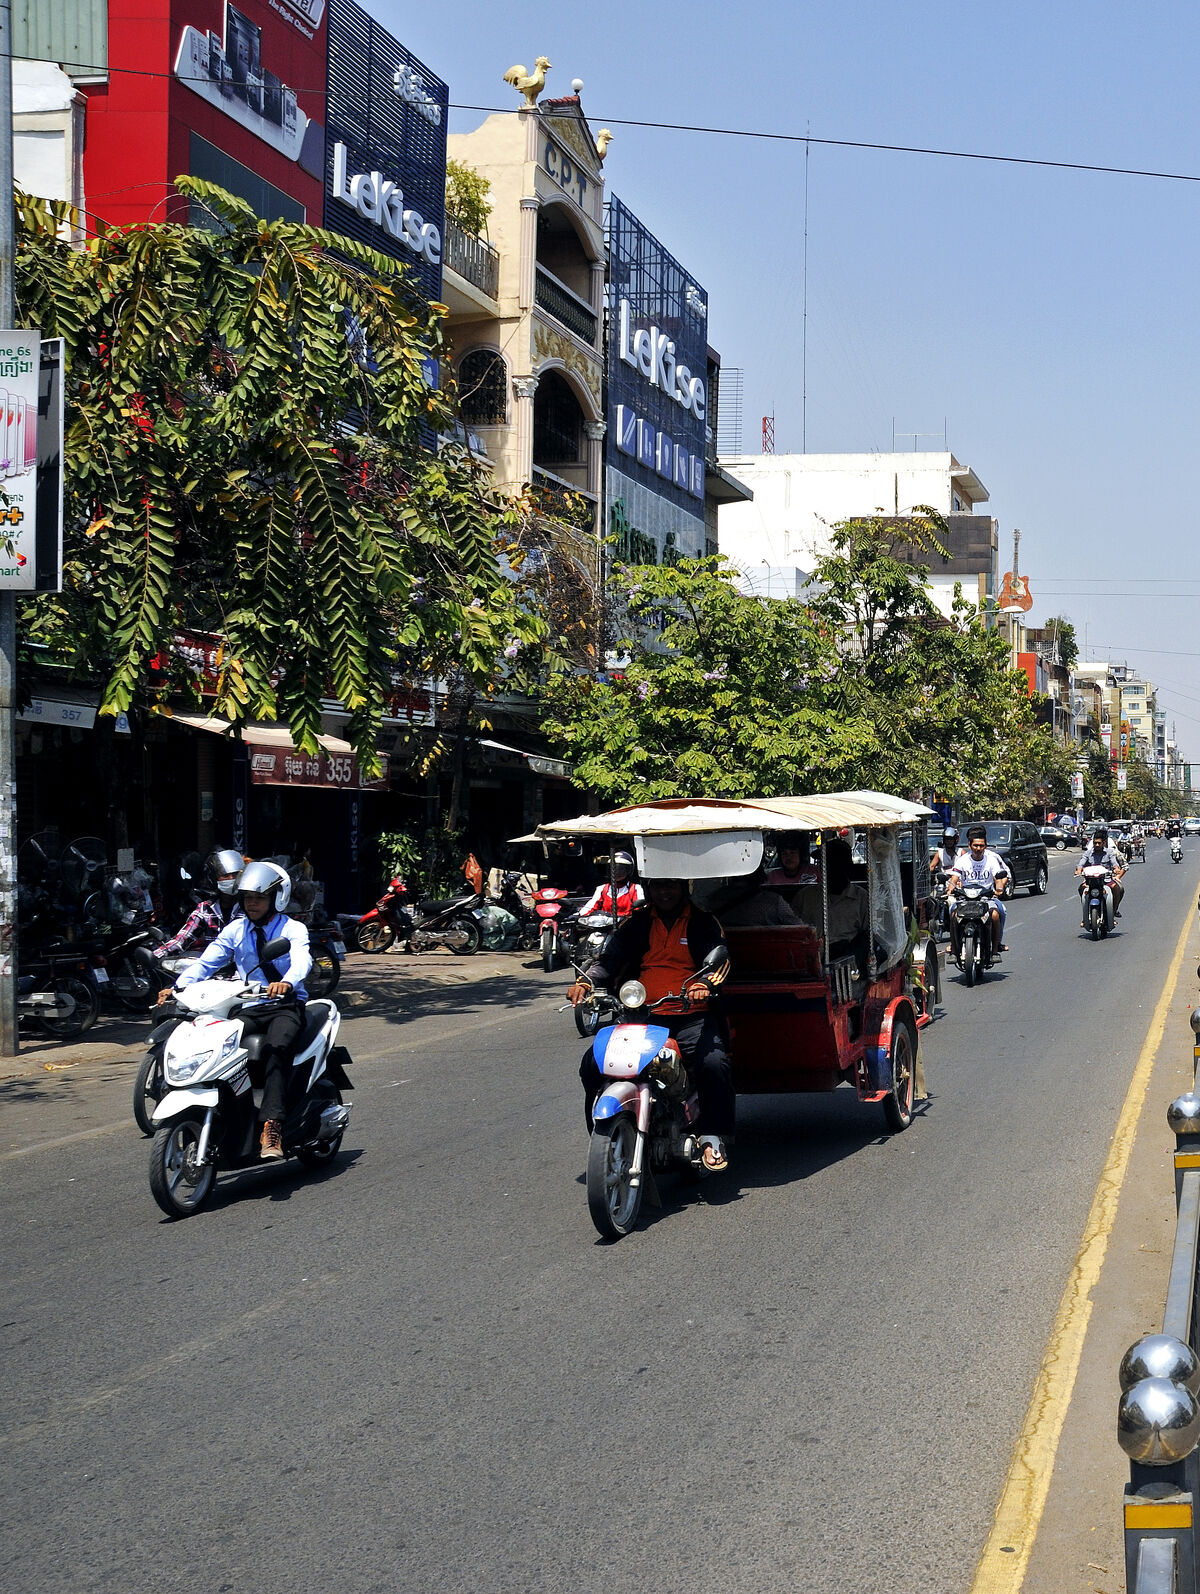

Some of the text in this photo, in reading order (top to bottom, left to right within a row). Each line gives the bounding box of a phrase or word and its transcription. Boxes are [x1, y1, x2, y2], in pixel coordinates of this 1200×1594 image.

[333, 142, 441, 264] LeKise
[17, 347, 31, 356] 6s
[619, 299, 705, 420] LeKise
[62, 709, 82, 721] 357
[326, 757, 352, 782] 355
[962, 870, 990, 880] POLO
